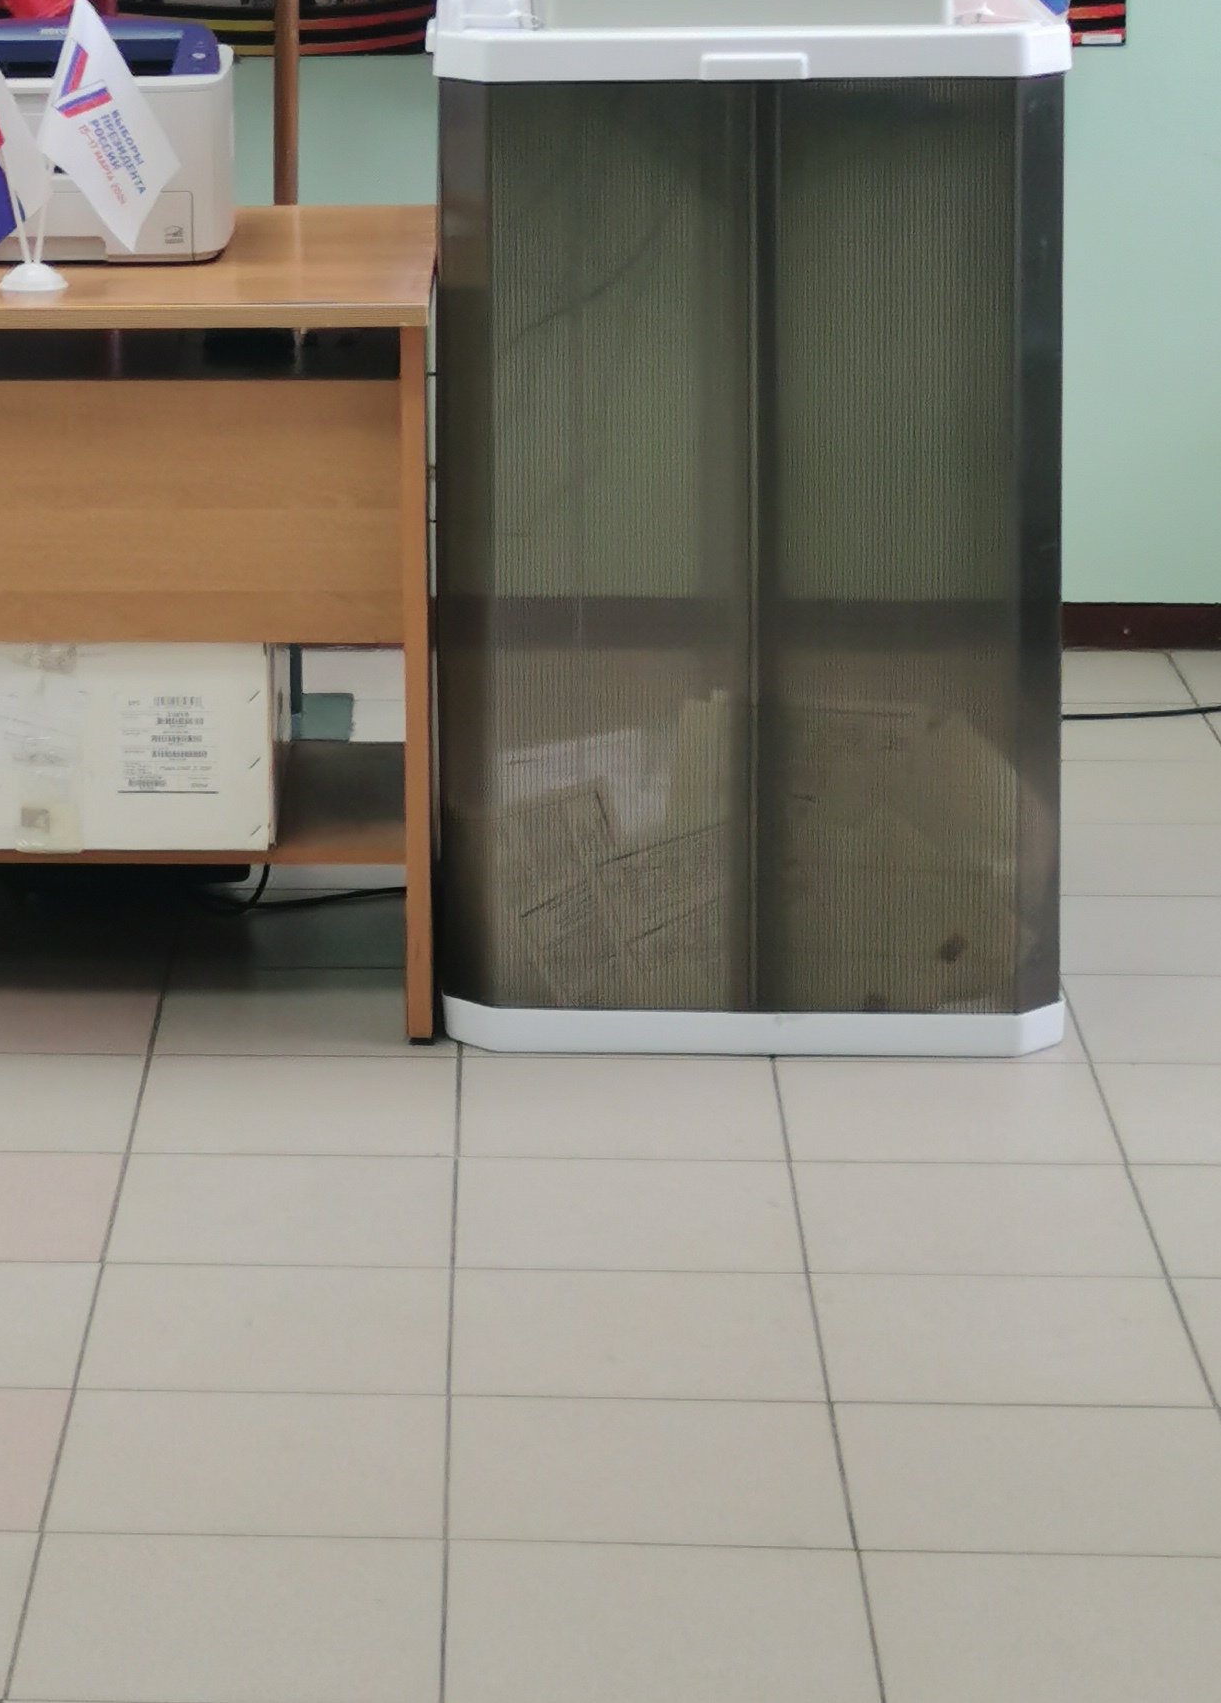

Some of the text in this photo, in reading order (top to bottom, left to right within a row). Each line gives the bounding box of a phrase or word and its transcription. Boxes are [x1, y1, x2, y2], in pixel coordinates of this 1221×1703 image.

[91, 119, 121, 169] РОССИИ
[101, 114, 146, 194] ПРЕЗИДЕНТА
[112, 109, 144, 166] ВЫБОРЫ
